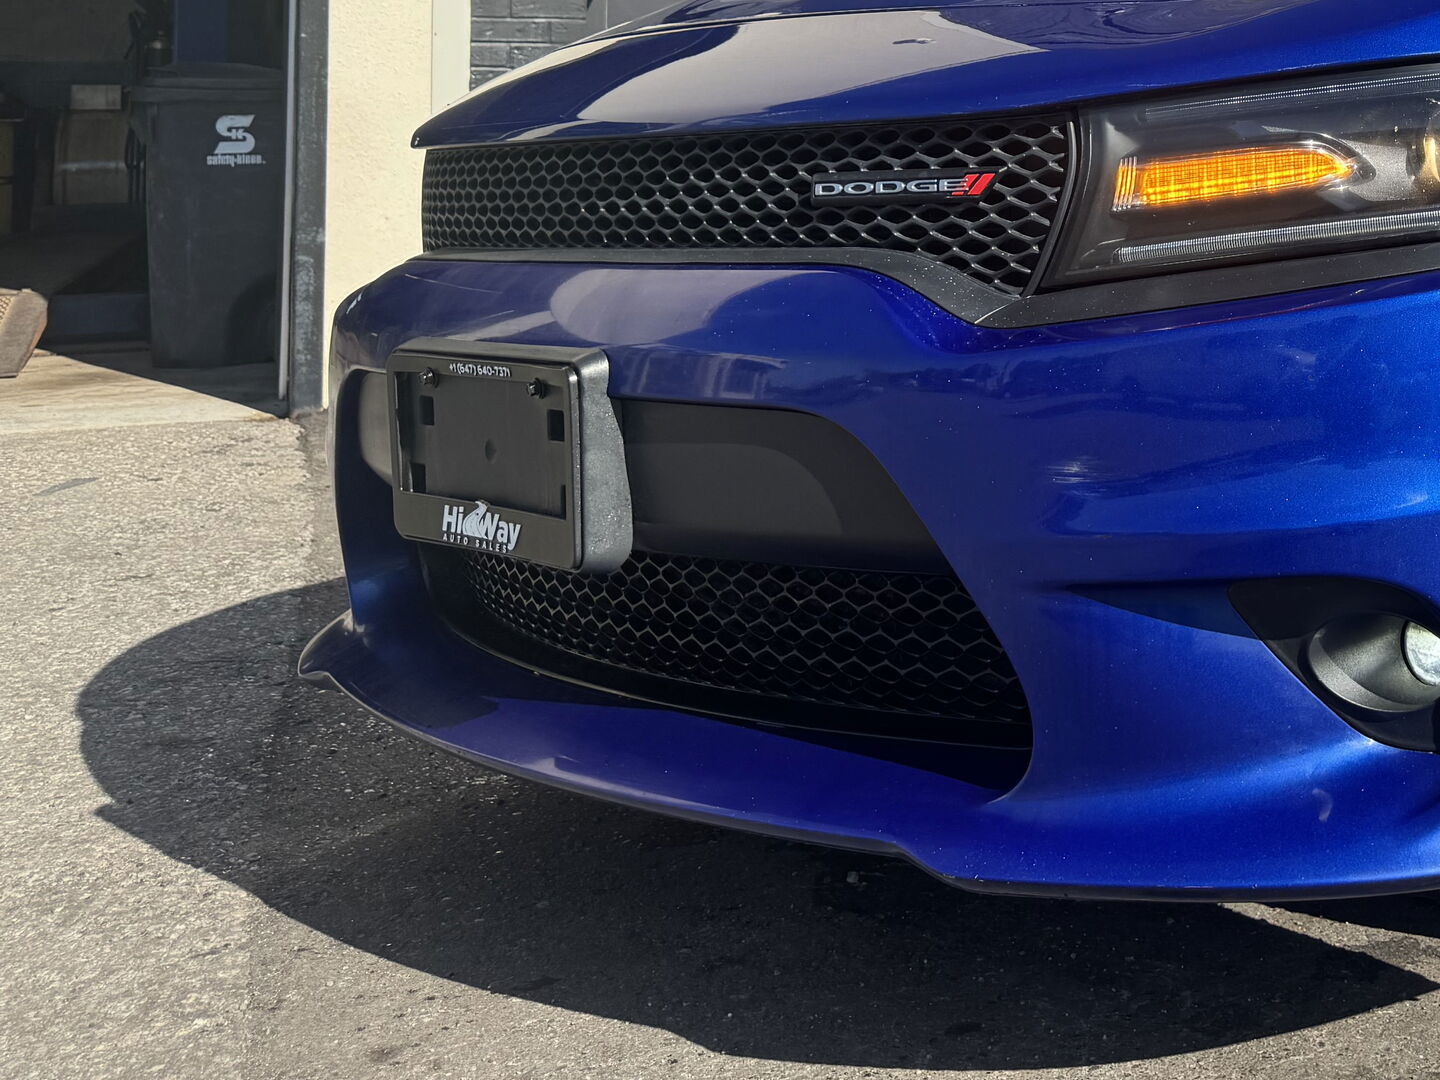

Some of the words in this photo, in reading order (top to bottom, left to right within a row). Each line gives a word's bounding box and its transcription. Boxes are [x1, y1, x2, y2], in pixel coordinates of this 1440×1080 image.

[815, 177, 969, 196] DODGE
[442, 533, 468, 545] AUTO
[475, 539, 507, 553] SALES
